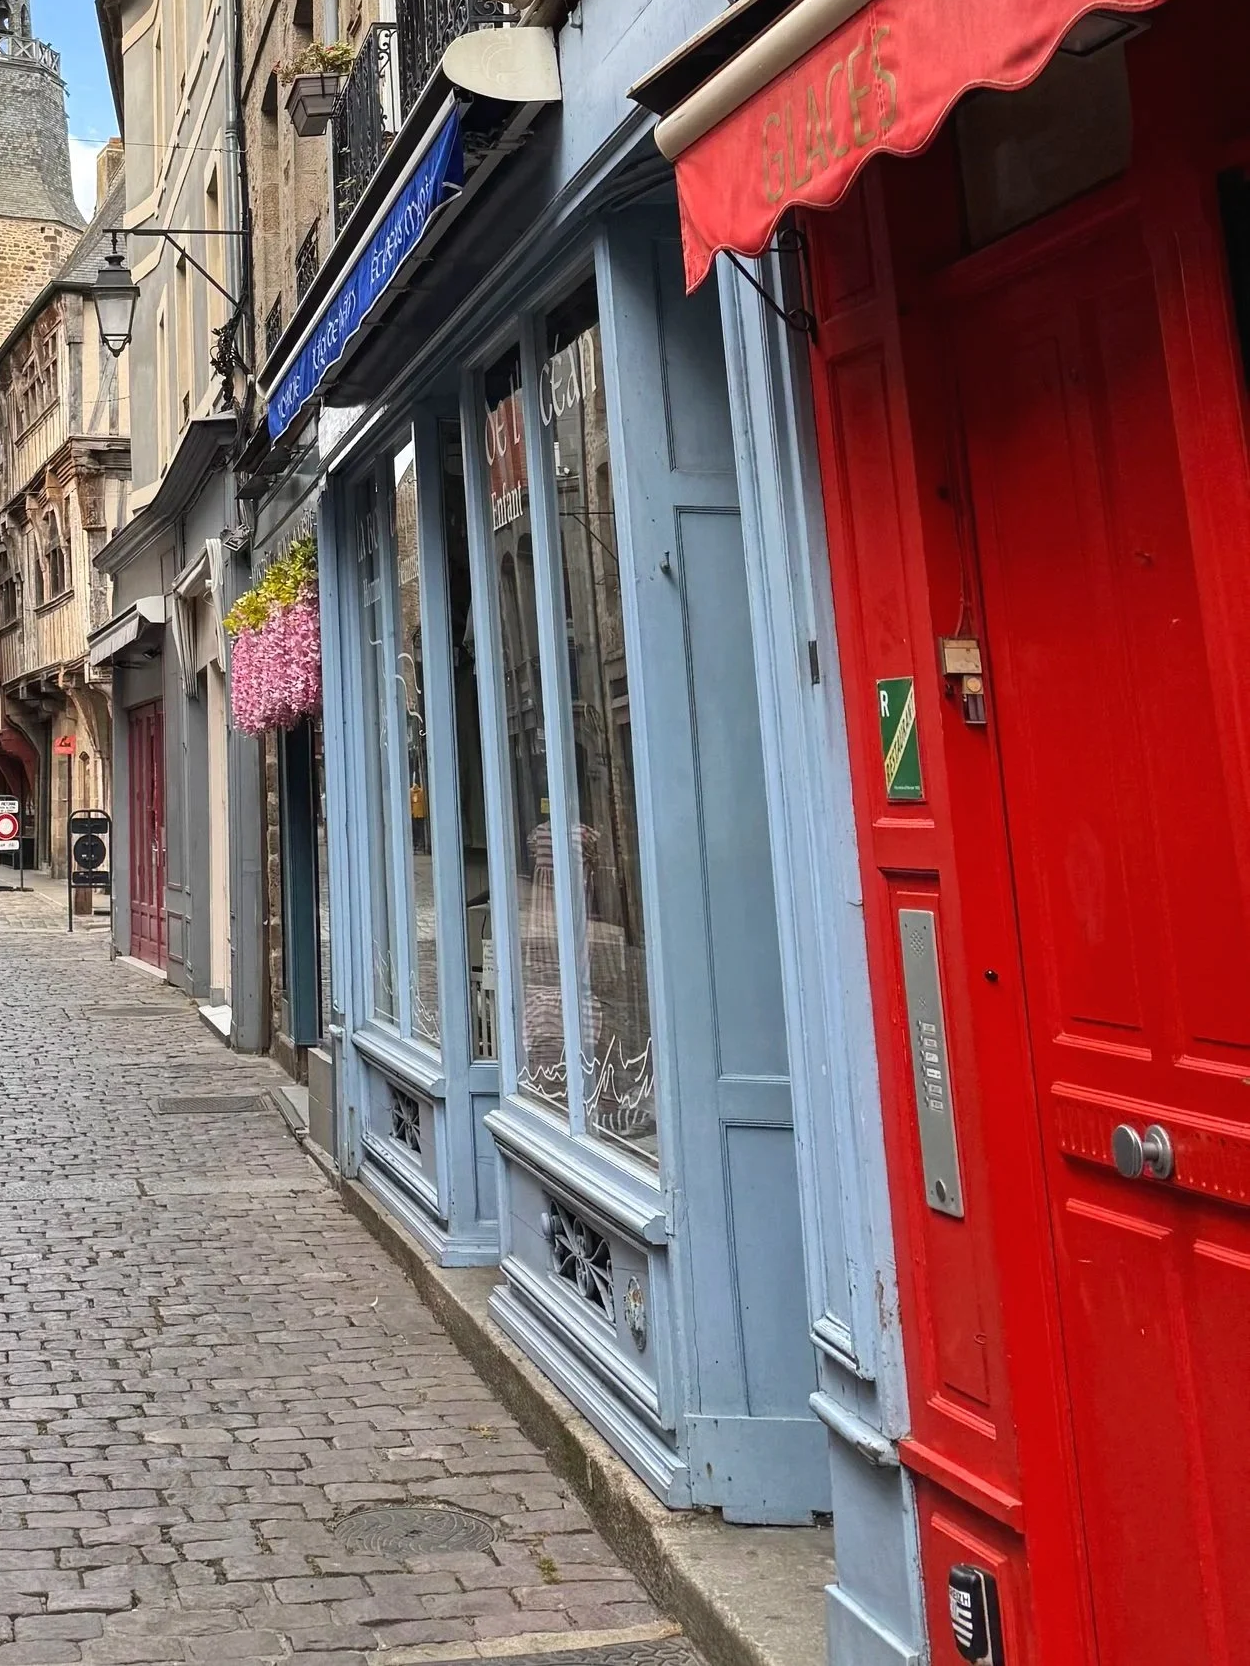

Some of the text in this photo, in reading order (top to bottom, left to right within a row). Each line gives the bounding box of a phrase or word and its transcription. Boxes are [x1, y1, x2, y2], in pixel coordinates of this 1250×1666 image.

[762, 24, 897, 203] GLACES
[490, 480, 524, 532] Enfant
[879, 690, 890, 718] R
